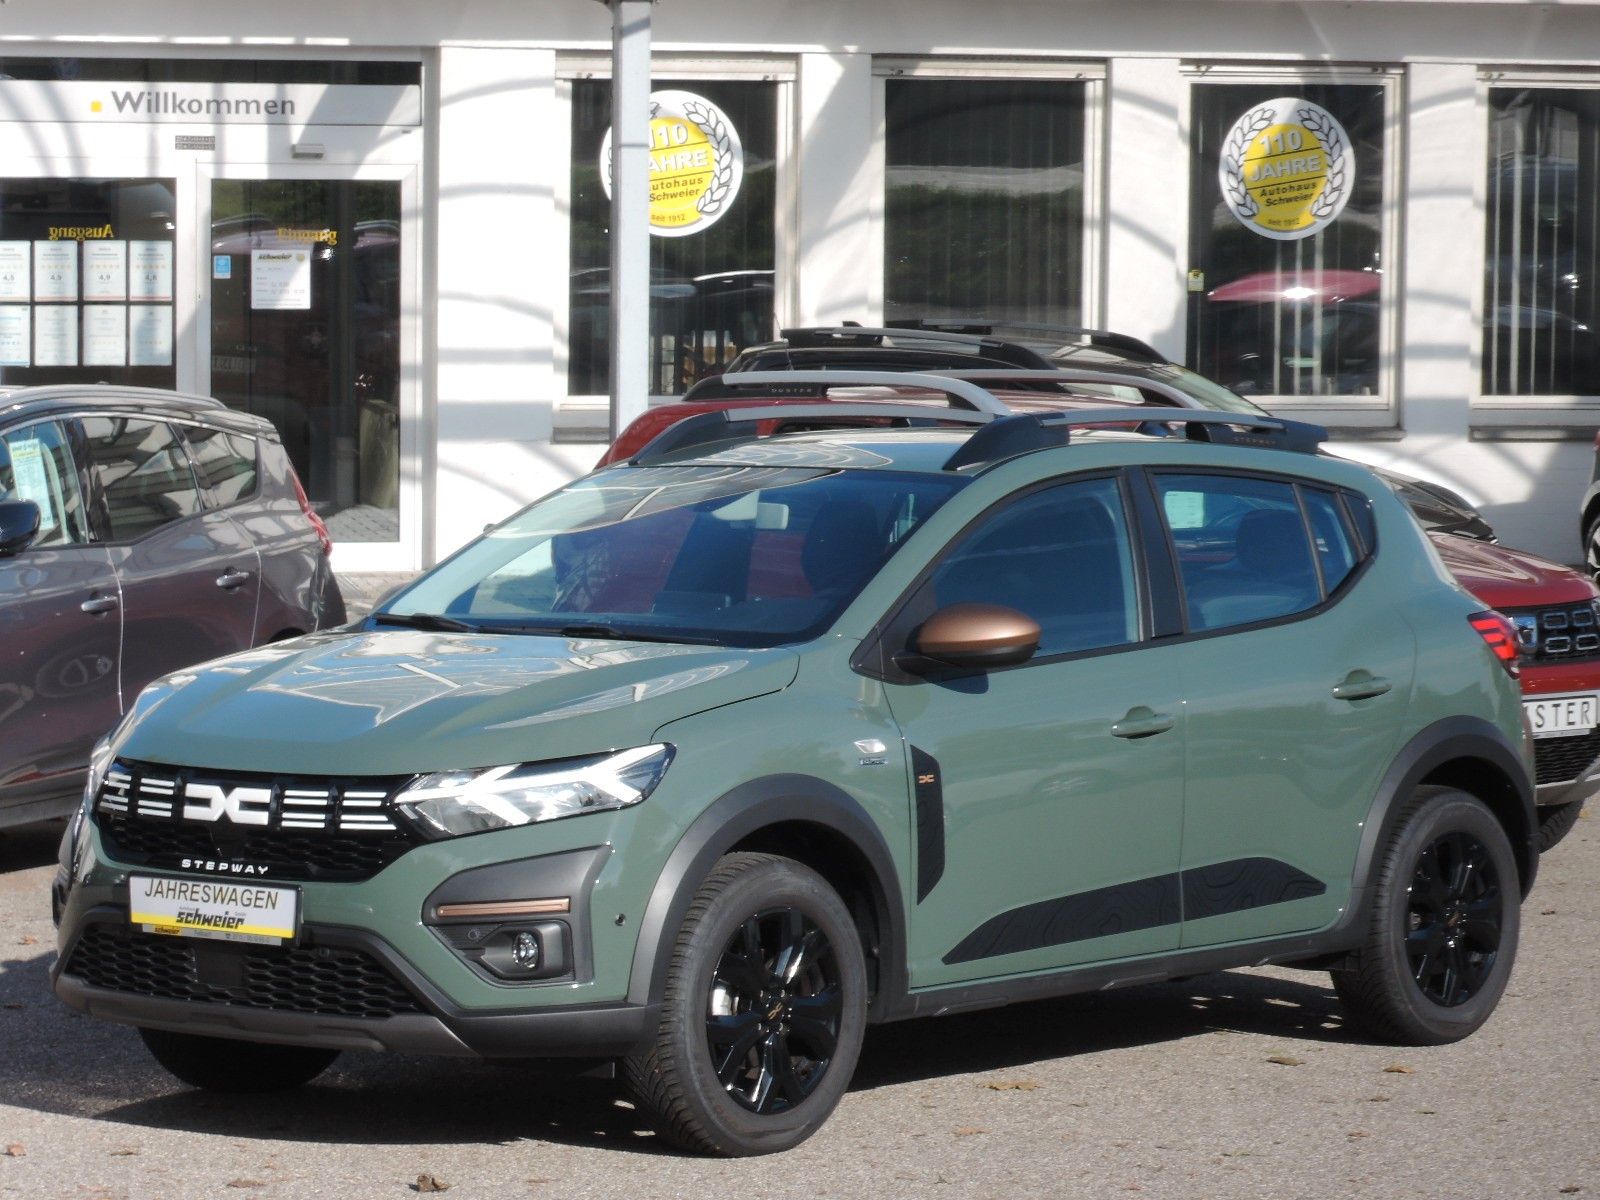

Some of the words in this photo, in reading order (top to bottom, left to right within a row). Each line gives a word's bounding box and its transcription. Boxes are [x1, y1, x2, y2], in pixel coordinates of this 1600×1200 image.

[111, 90, 296, 116] Willkommen
[1260, 130, 1303, 156] 110
[648, 148, 710, 174] AHRE
[1251, 156, 1321, 181] JAHRE
[648, 187, 701, 202] Schweier
[650, 177, 704, 191] utohaus
[1260, 182, 1317, 196] Autohaus
[1265, 193, 1312, 207] Schweier
[1535, 702, 1590, 728] STER
[181, 859, 269, 874] STEPWAY
[145, 879, 278, 909] JAHRESWAGEN
[175, 907, 246, 930] schweier
